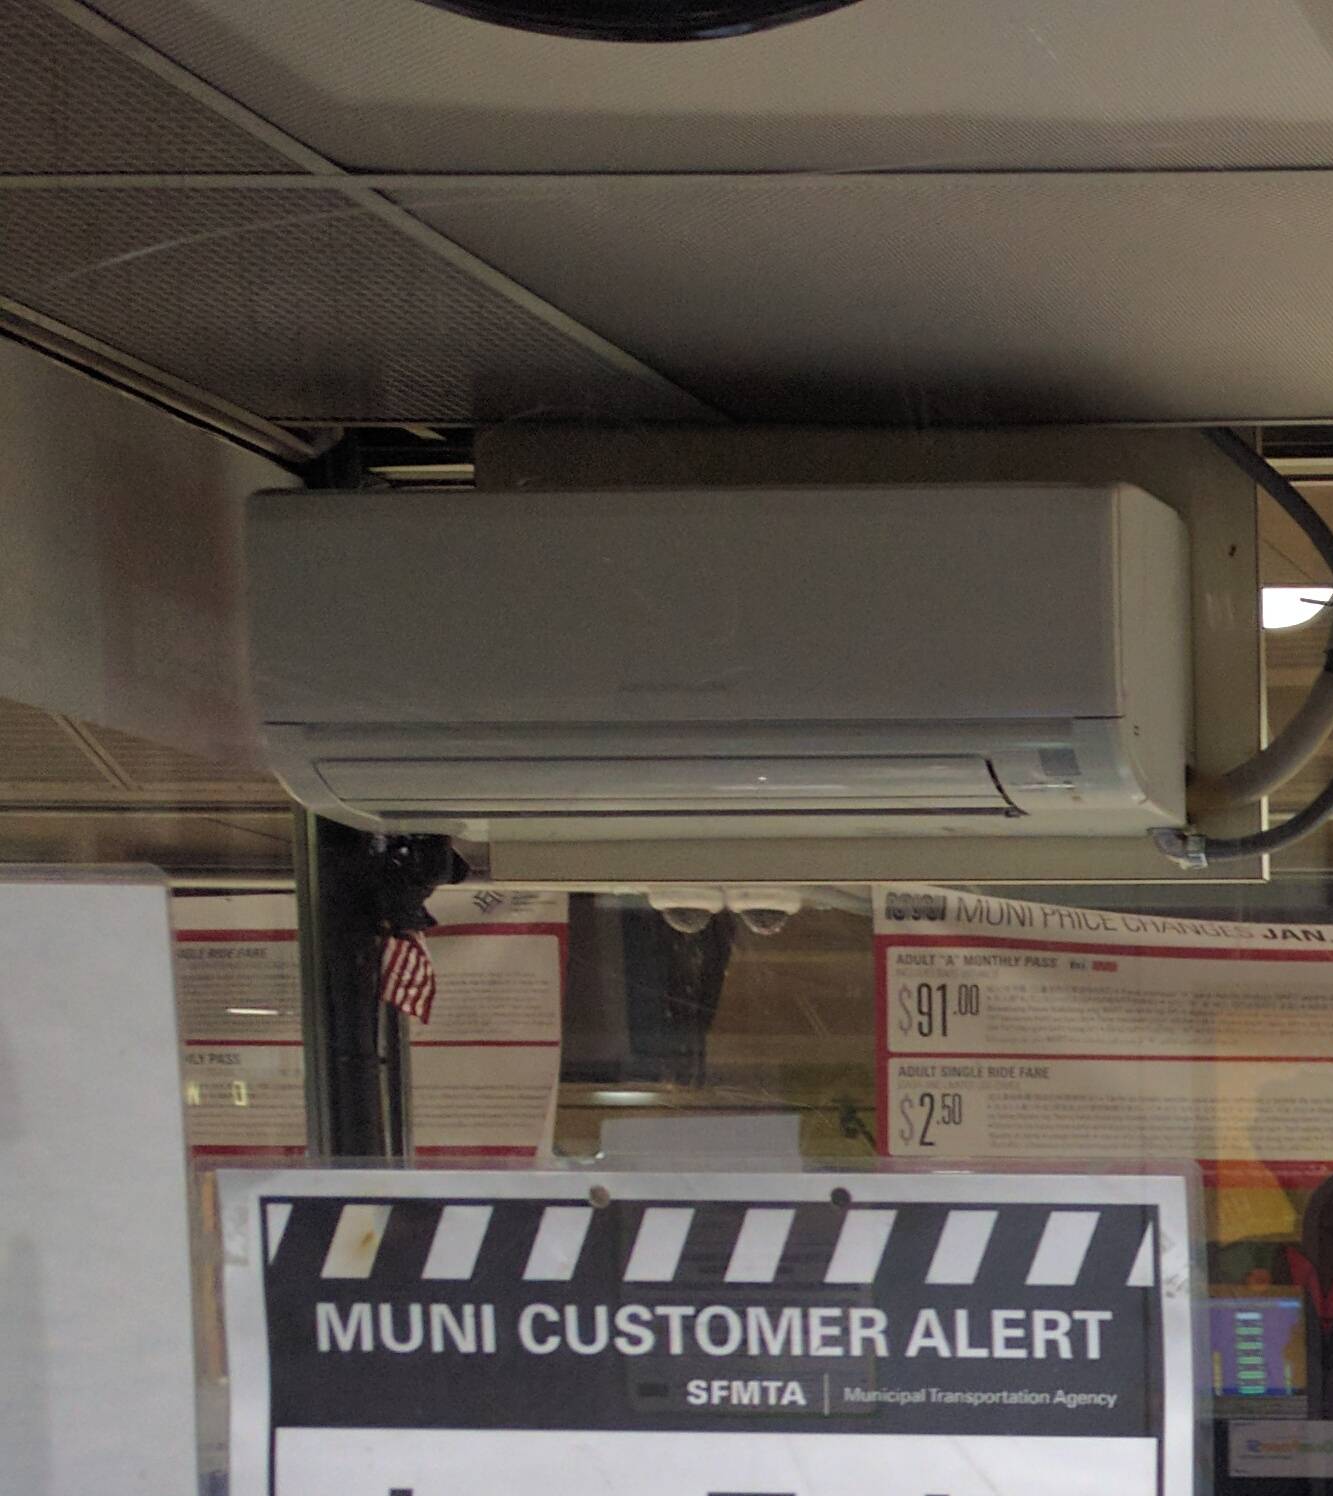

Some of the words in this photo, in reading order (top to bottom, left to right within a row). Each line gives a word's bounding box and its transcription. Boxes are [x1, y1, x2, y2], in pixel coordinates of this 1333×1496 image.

[956, 898, 1034, 927] MUNI
[1043, 905, 1117, 932] PRICE
[1125, 914, 1254, 940] CHANGES
[896, 954, 935, 965] ADULT
[963, 955, 1022, 967] MONTHLY
[1024, 957, 1058, 968] PASS
[898, 1066, 936, 1078] ADULT
[941, 1066, 983, 1078] SINGLE
[987, 1067, 1015, 1078] RIDE
[1019, 1067, 1050, 1079] FARE
[902, 1092, 962, 1147] $2.50
[316, 1303, 495, 1355] MUNI
[517, 1304, 888, 1359] CUSTOMER
[905, 1309, 1114, 1360] ALERT
[686, 1379, 806, 1406] SFMTA
[843, 1386, 925, 1405] Municipal
[928, 1387, 1049, 1407] Transportation
[1053, 1390, 1118, 1408] Agency
